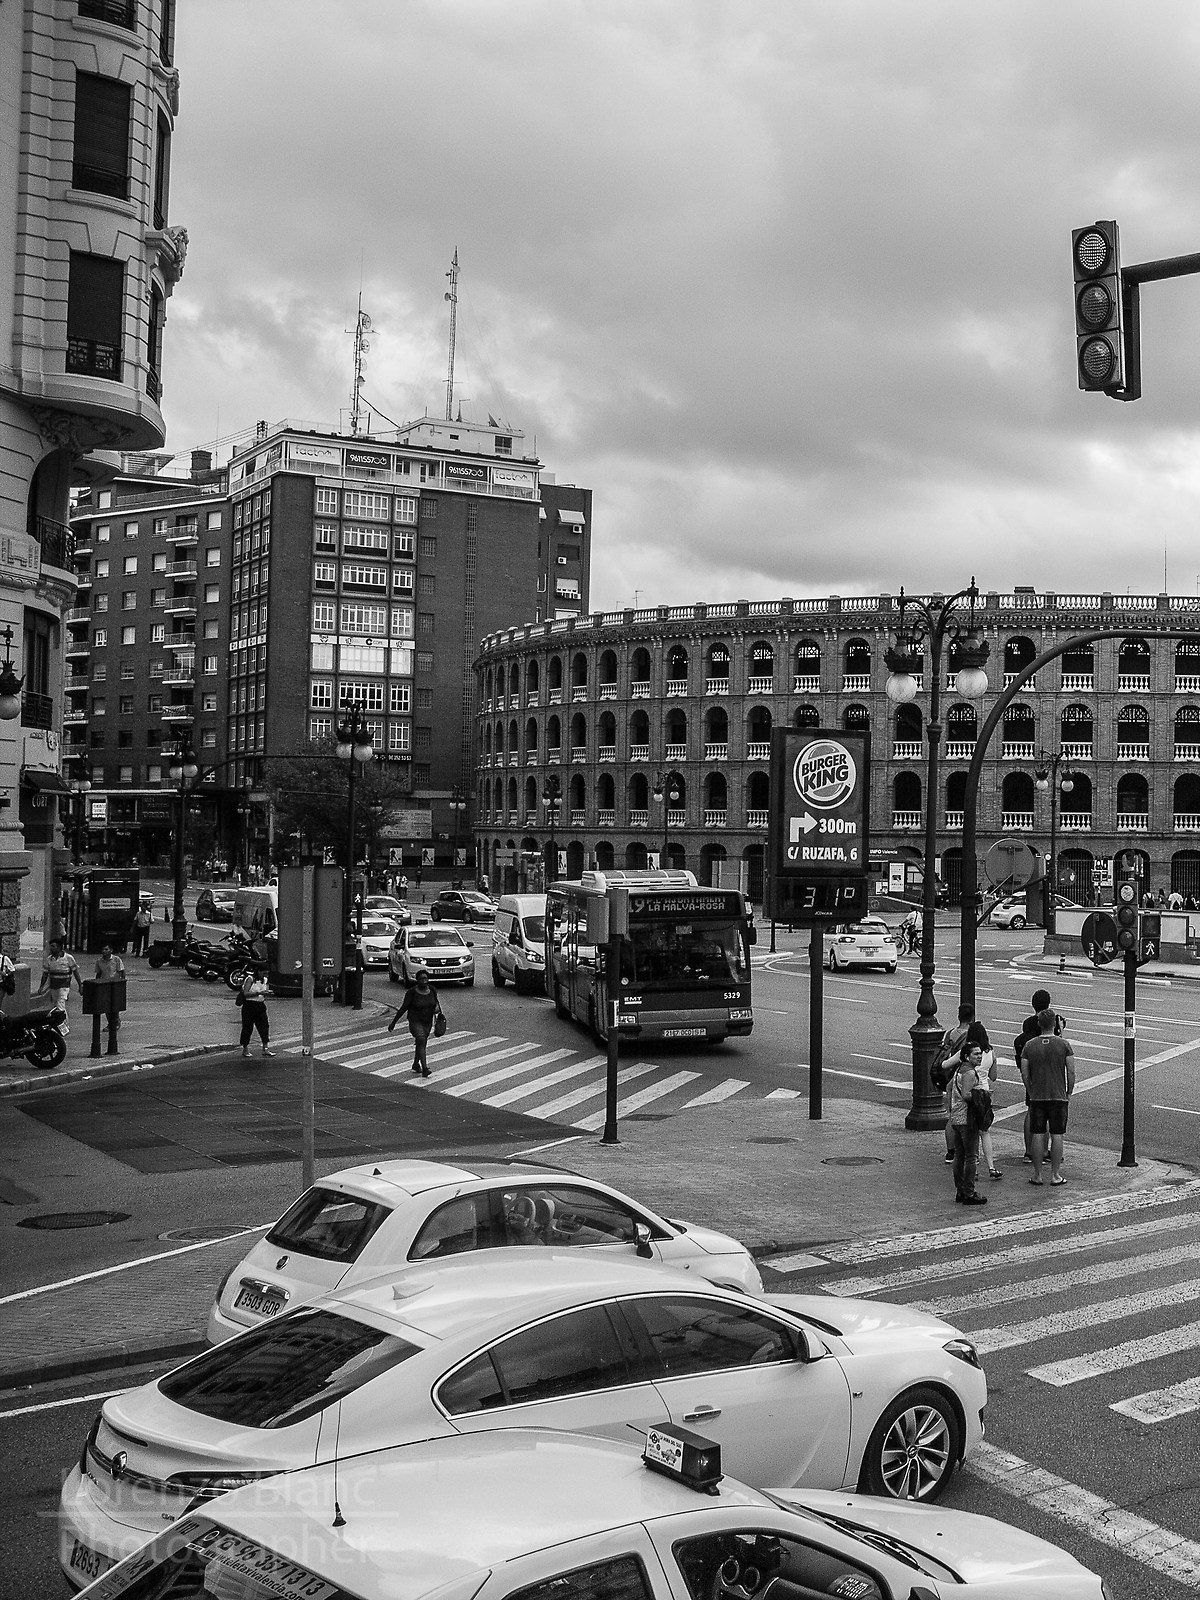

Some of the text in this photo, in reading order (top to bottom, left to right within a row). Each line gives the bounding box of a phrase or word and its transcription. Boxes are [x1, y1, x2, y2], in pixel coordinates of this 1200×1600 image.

[801, 753, 847, 777] BURGER
[802, 765, 849, 793] KING
[818, 818, 857, 834] 300m
[787, 846, 858, 862] C/ RUZAFA, 6
[648, 902, 725, 912] LA MALVA-ROSA
[723, 991, 741, 999] 5329
[241, 1292, 280, 1316] 3503 GDR
[74, 1546, 101, 1578] 2693
[235, 1545, 326, 1596] 96 357 13 13
